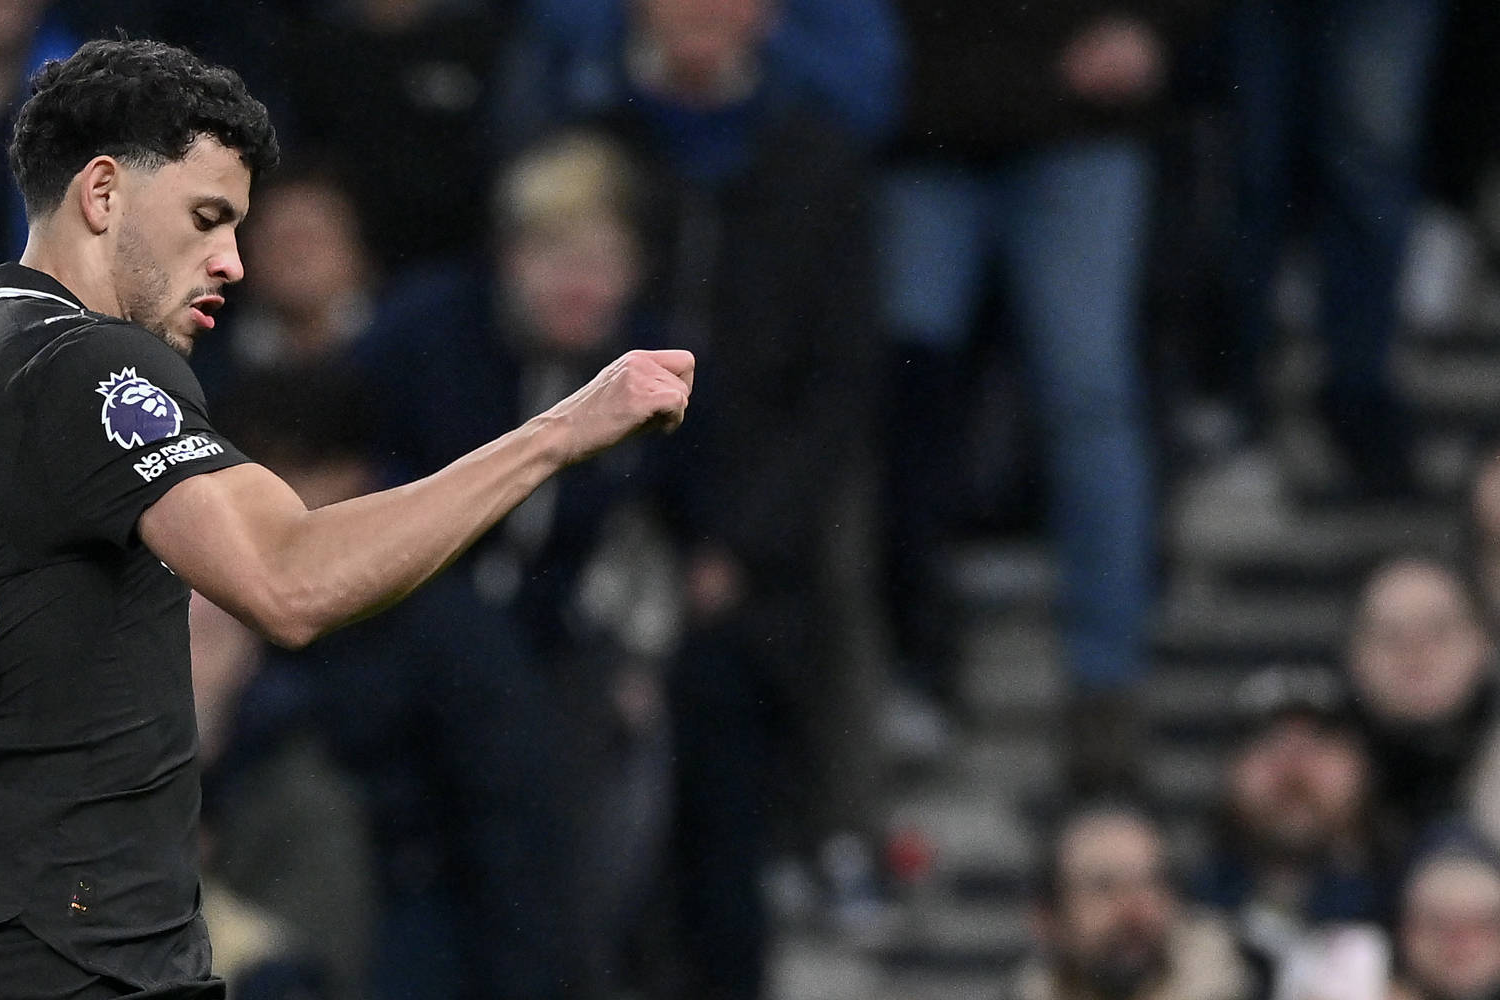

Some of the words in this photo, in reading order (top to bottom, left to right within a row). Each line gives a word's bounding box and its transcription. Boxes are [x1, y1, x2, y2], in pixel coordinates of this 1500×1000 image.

[133, 452, 161, 475] No
[160, 435, 209, 457] room
[142, 460, 167, 483] for
